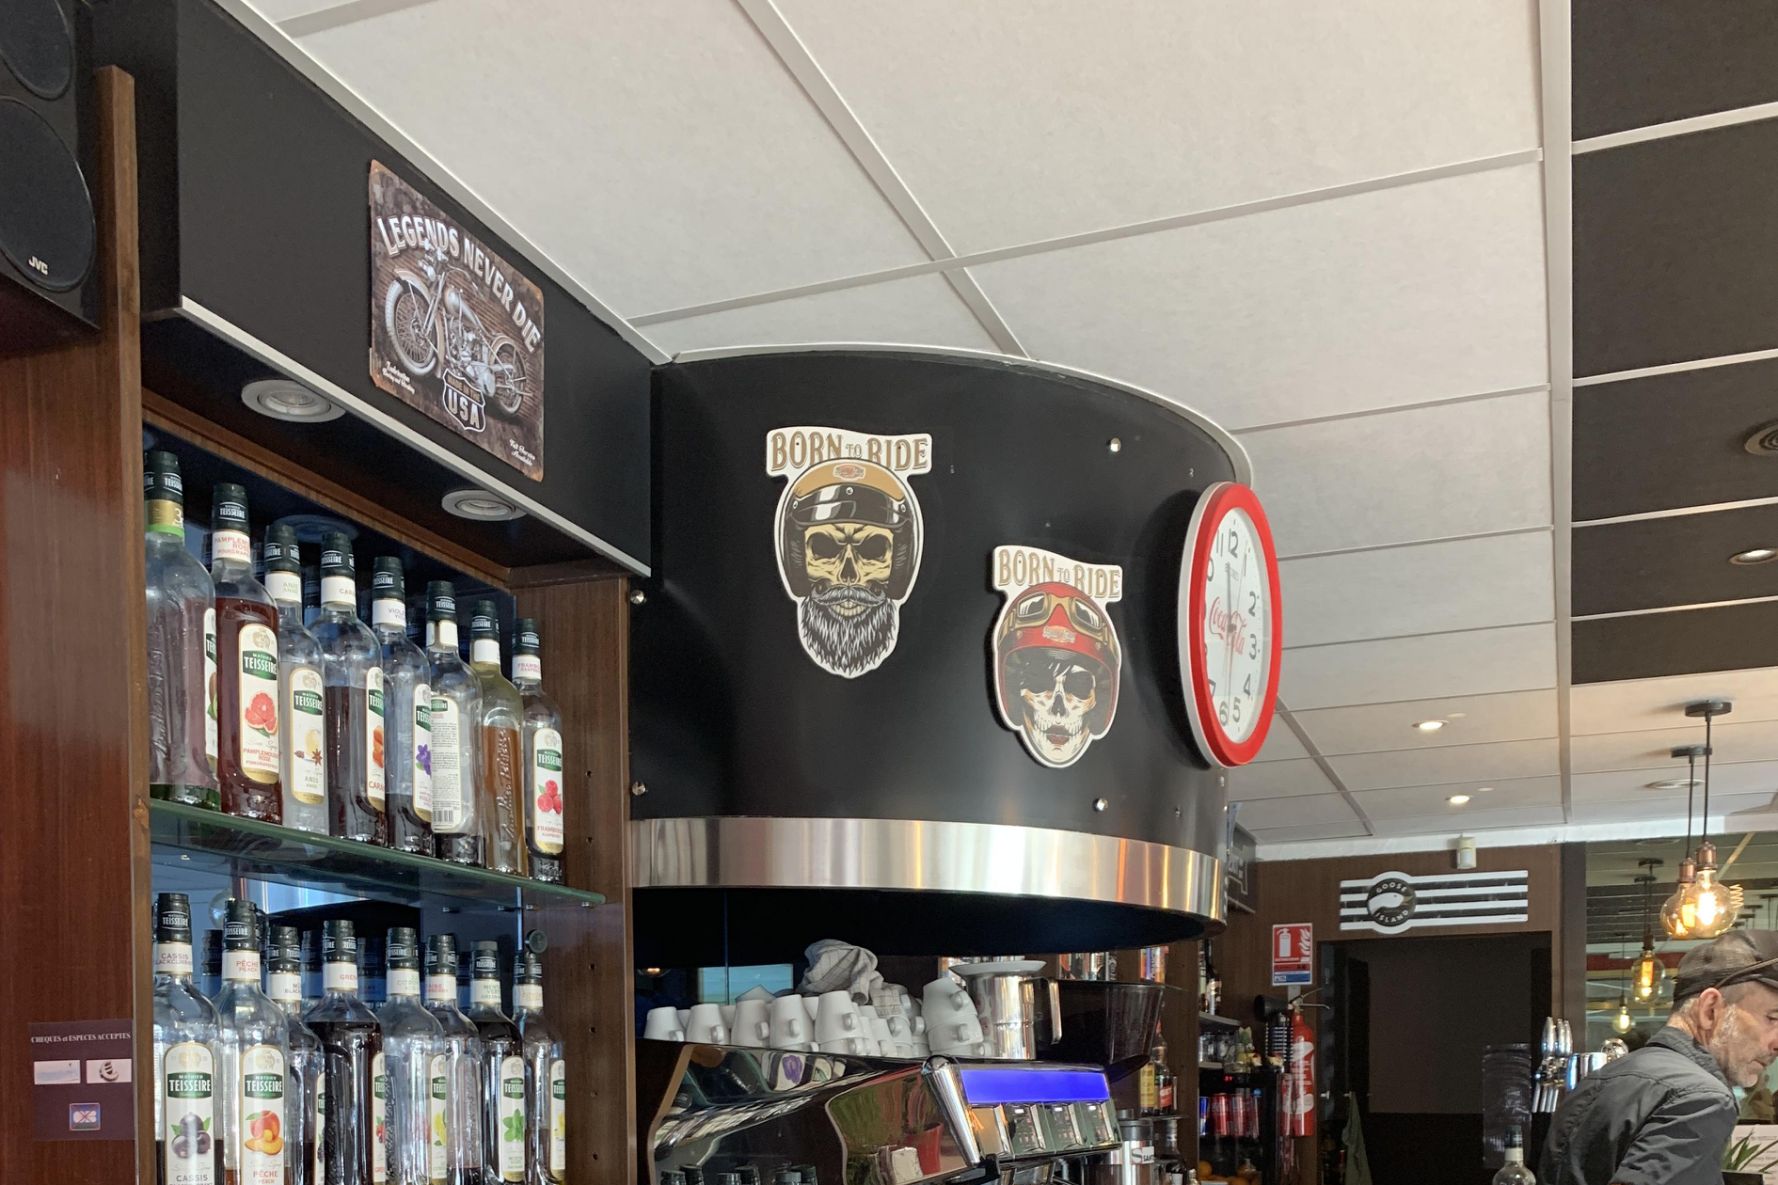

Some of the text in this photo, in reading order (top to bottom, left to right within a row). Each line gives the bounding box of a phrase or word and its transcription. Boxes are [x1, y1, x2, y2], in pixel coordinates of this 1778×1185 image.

[29, 256, 48, 275] JVC
[377, 215, 541, 353] LEGENDS NEVER DIE
[448, 388, 480, 428] USA
[771, 431, 928, 471] BORN TO RIDE
[1228, 528, 1239, 558] 12
[998, 549, 1120, 598] BORN TO RIDE
[1248, 591, 1256, 617] 2
[1249, 633, 1257, 660] 3
[1243, 673, 1251, 700] 4
[1219, 701, 1229, 727] 6
[1232, 696, 1241, 723] 5
[1376, 881, 1408, 893] GOOSE
[1375, 909, 1409, 923] ISLAND
[169, 1079, 211, 1092] TEISSEIRE
[246, 1080, 282, 1092] TEISSEIRE
